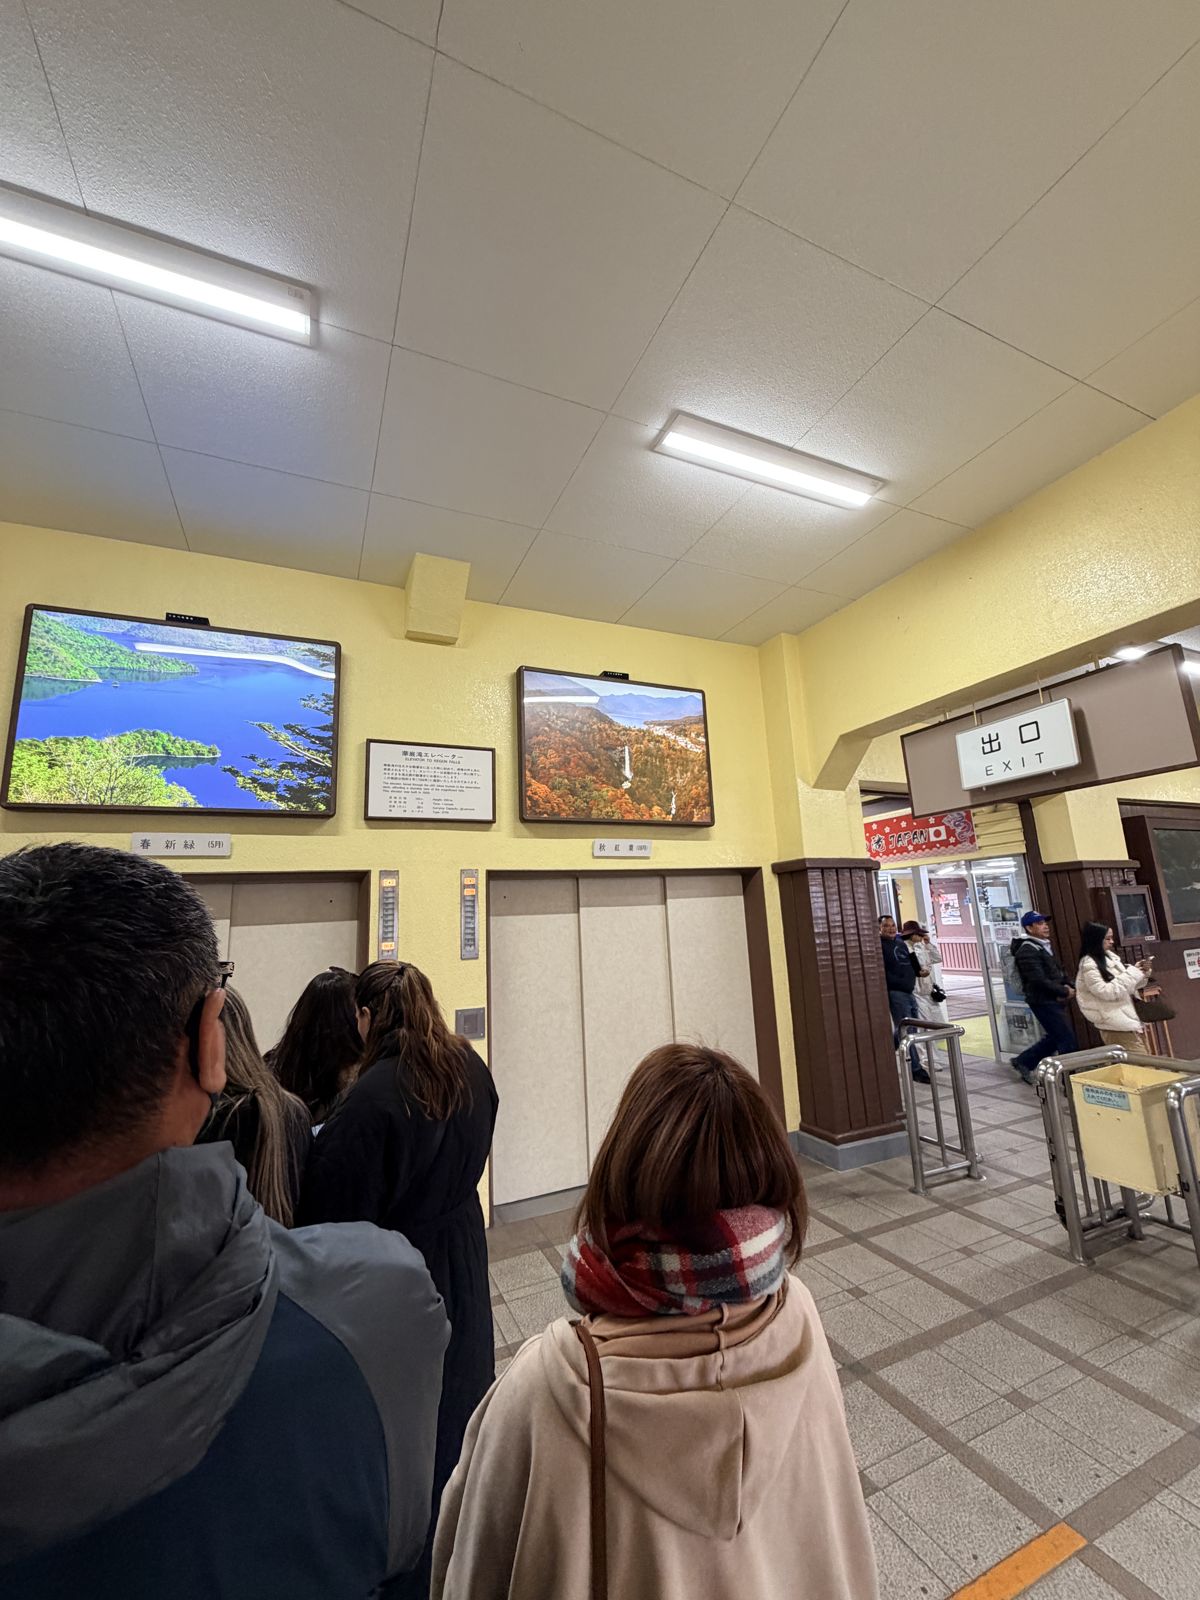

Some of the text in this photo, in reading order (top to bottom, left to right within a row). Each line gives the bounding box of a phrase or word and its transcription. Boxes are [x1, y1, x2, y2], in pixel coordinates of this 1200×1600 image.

[981, 721, 1041, 755] 出口
[985, 752, 1044, 776] EXIT
[140, 838, 151, 849] 春
[889, 828, 928, 849] JAPAN
